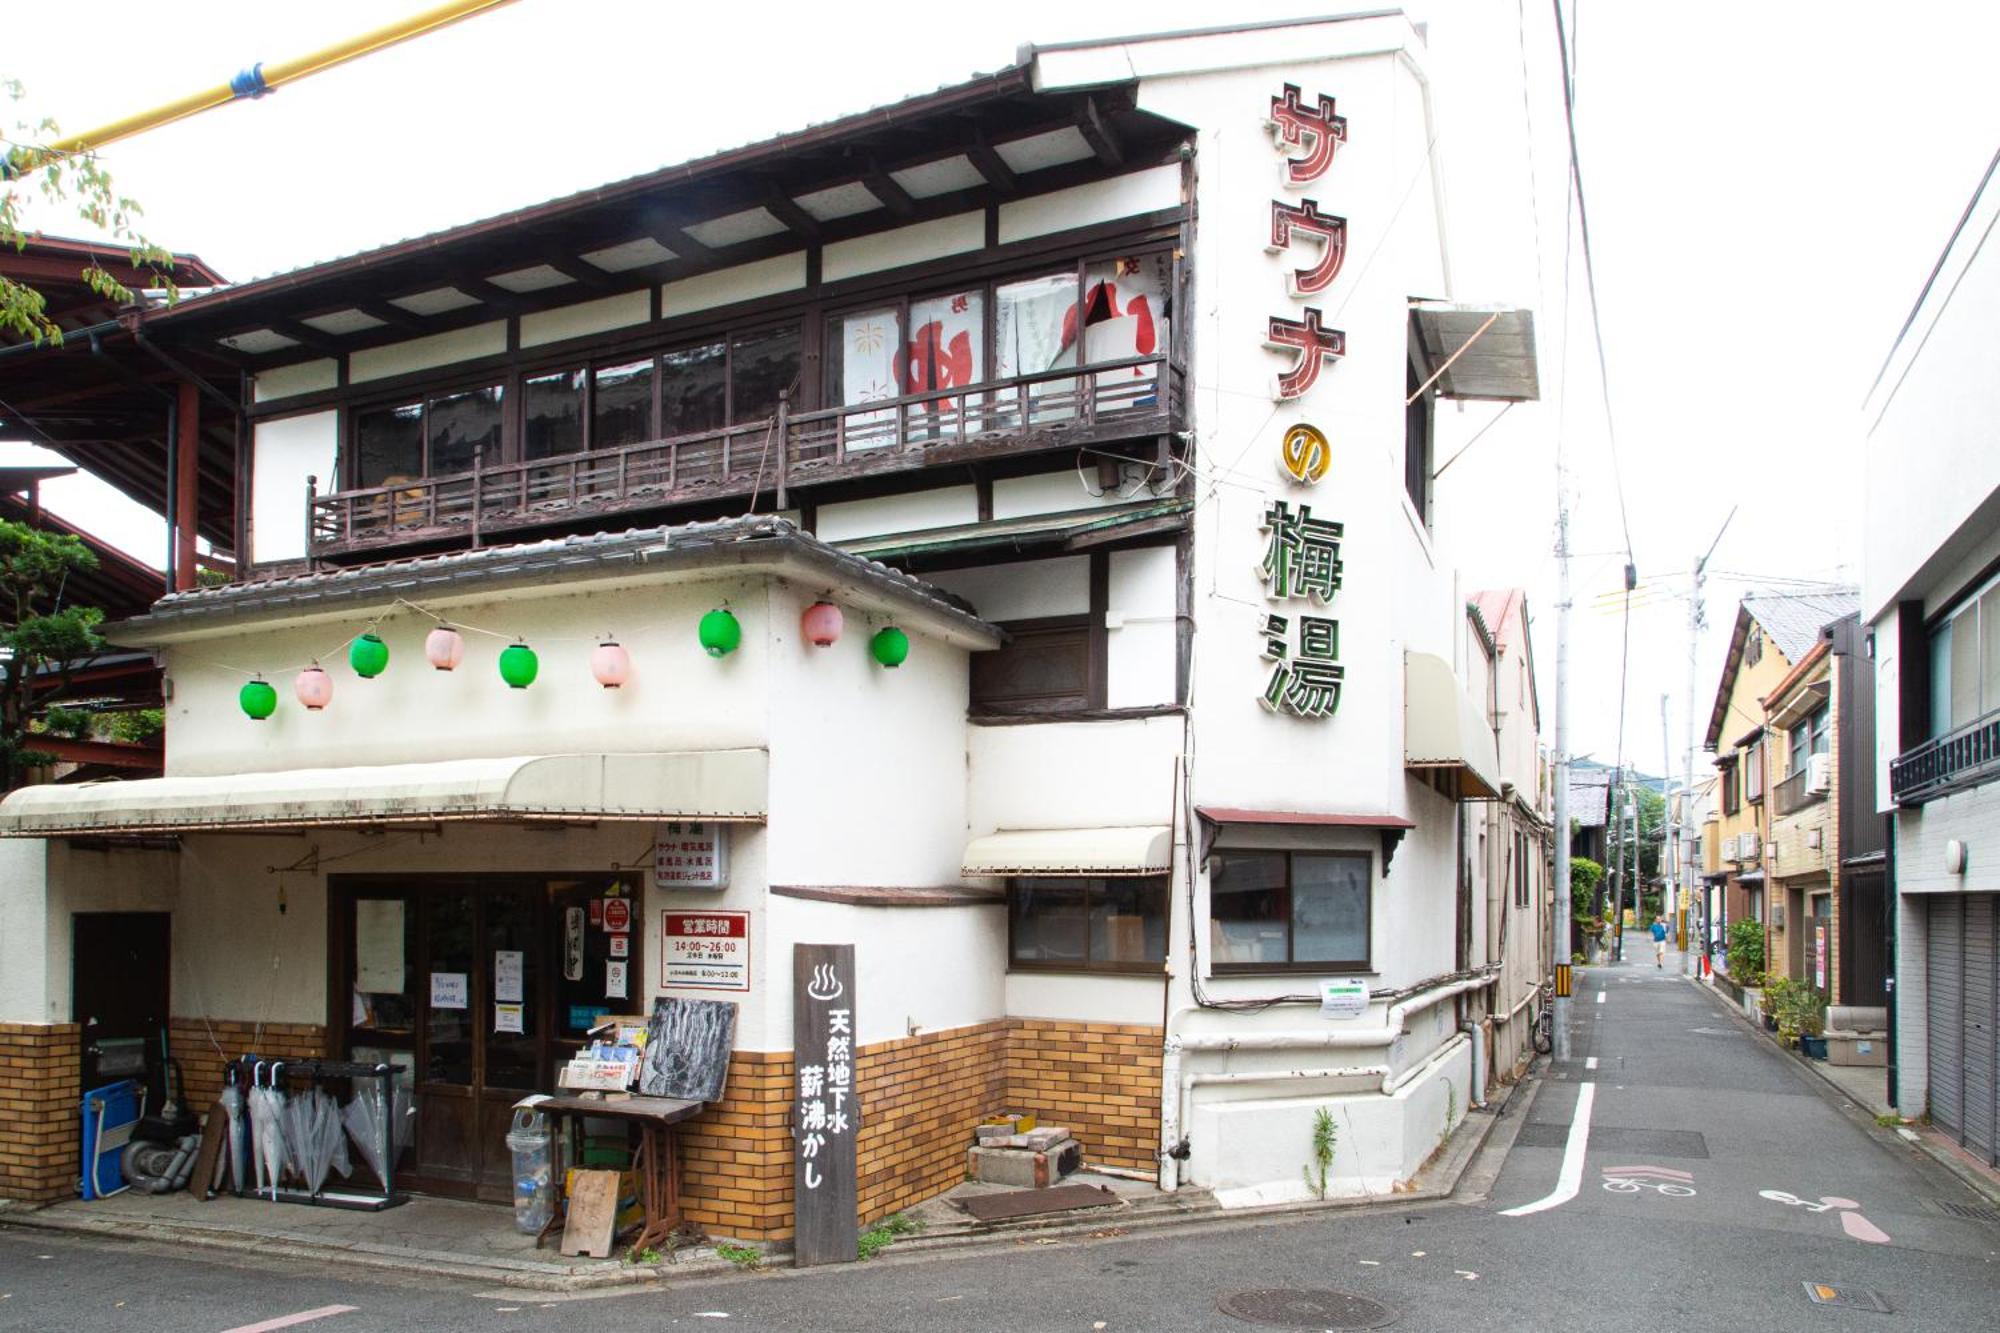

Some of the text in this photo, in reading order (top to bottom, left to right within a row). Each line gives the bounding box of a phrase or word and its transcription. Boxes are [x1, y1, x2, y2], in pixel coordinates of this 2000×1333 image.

[1261, 81, 1348, 718] サウナの梅湯
[683, 919, 730, 934] 営業時間
[800, 1065, 826, 1189] 薪沸かし
[827, 1008, 851, 1134] 天然地下水
